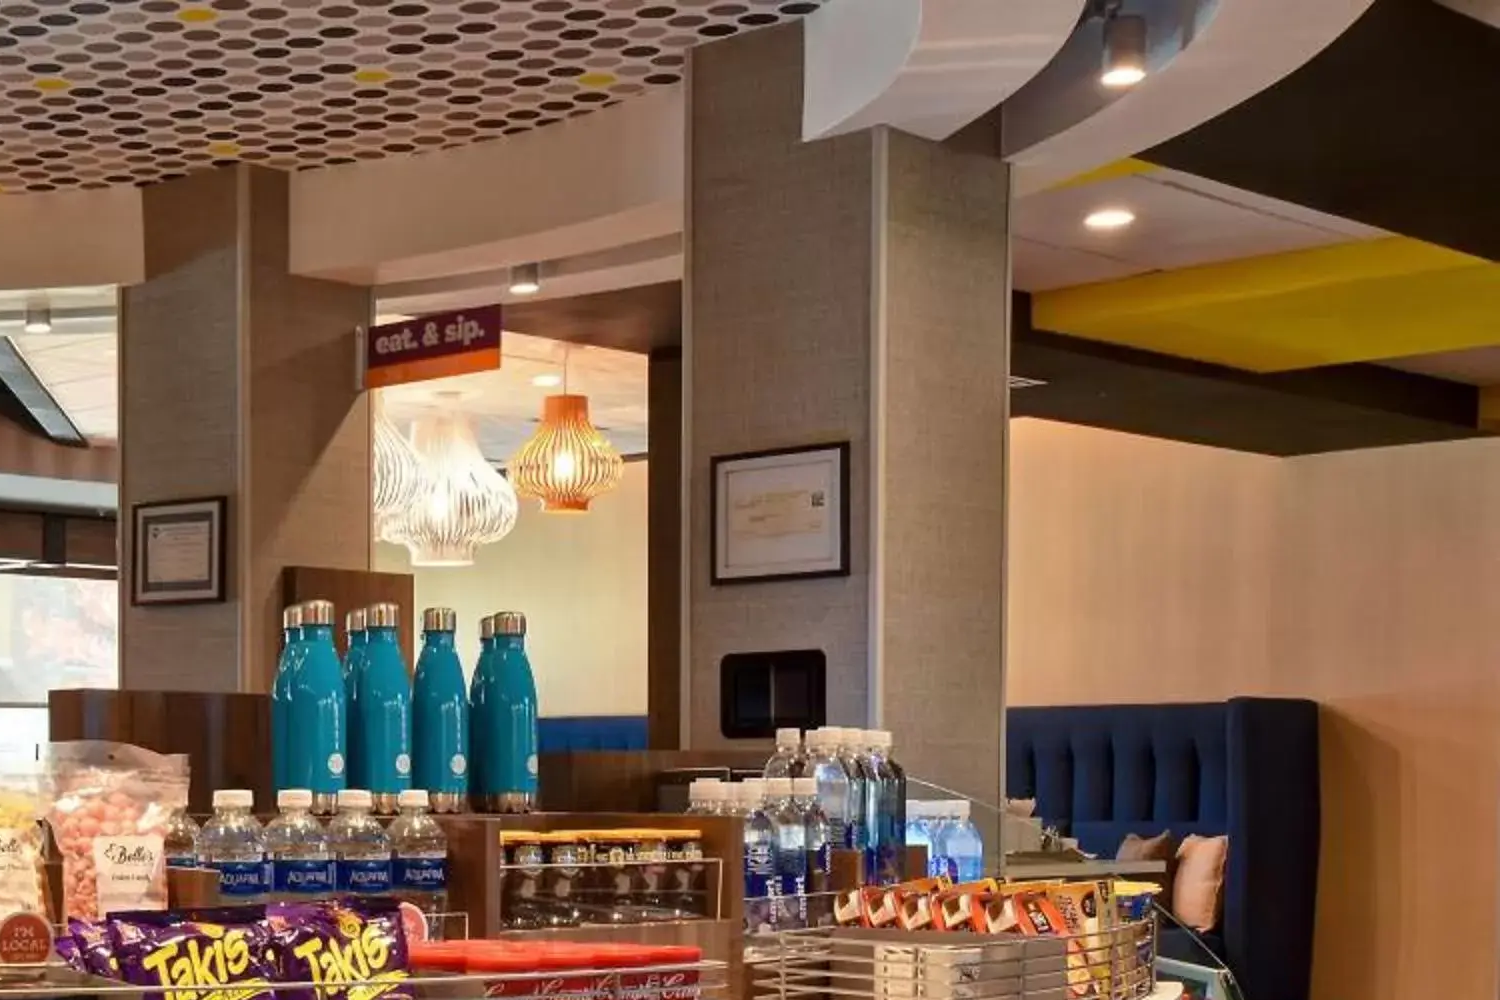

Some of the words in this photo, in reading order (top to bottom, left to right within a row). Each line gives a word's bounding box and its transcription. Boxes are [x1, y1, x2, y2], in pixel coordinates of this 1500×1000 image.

[375, 328, 419, 354] eat.
[422, 321, 439, 347] &
[445, 315, 485, 346] sip.
[2, 940, 49, 952] LOCAL
[294, 924, 389, 1000] Takis
